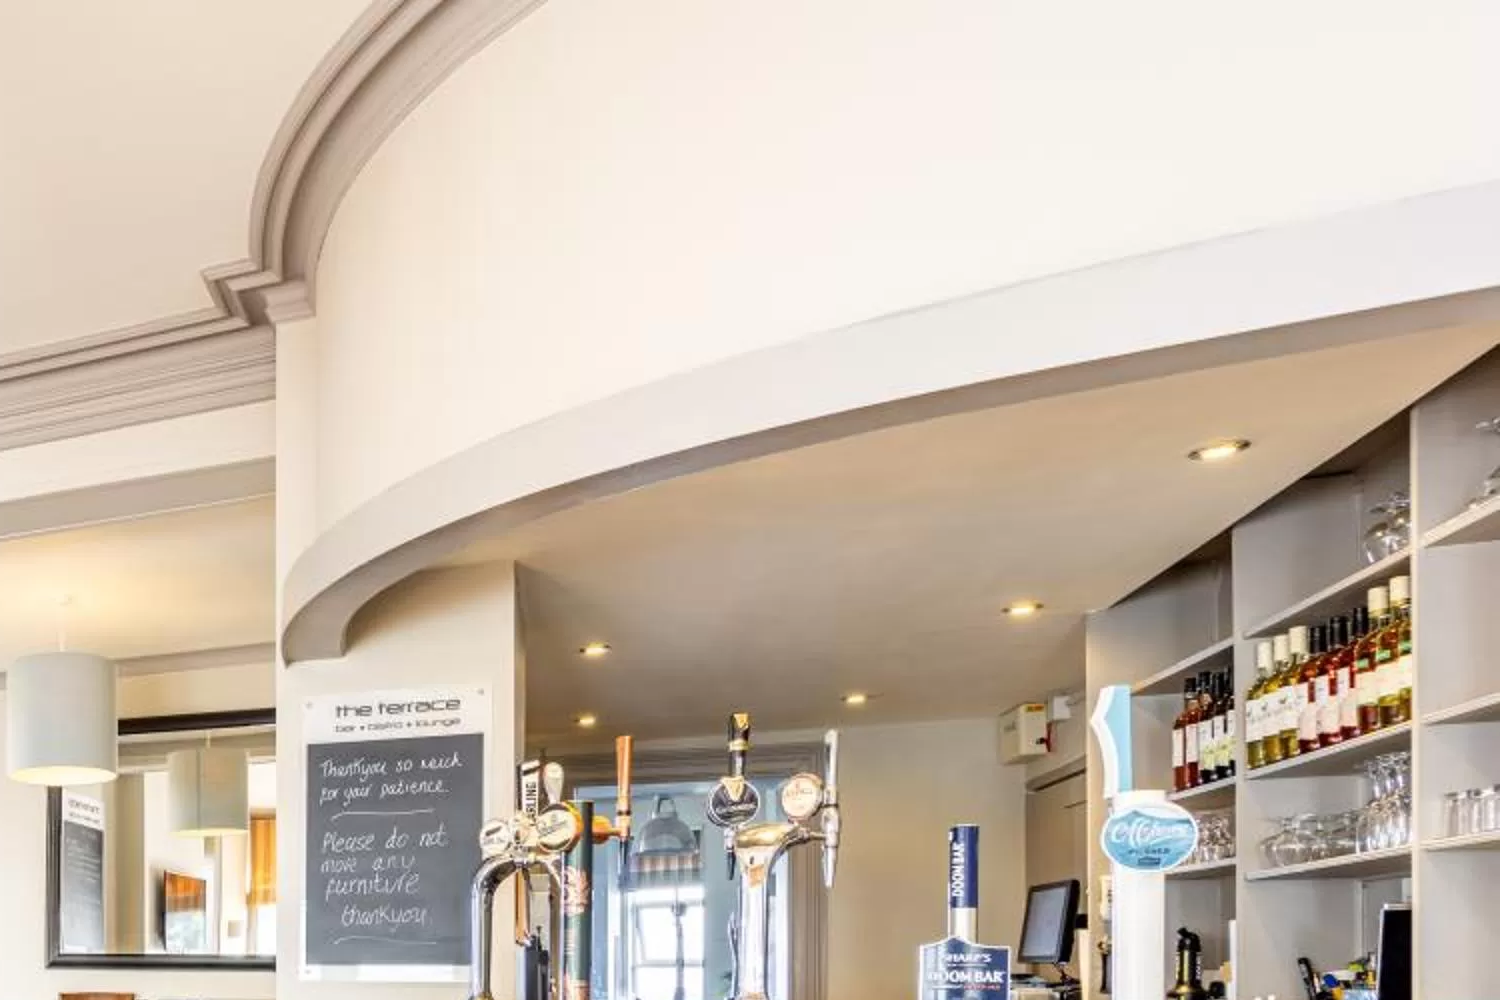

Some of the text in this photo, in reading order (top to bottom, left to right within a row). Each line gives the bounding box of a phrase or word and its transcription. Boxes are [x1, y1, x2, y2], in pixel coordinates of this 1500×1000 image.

[336, 699, 461, 718] the terrace
[336, 724, 356, 733] bar
[415, 717, 461, 728] lounge
[395, 759, 413, 773] so
[343, 783, 373, 807] your
[322, 822, 450, 854] Please do not
[320, 856, 416, 875] move any
[952, 842, 965, 897] DOOM BAR
[325, 872, 421, 901] furniture
[927, 970, 1007, 984] DOOM BAR
